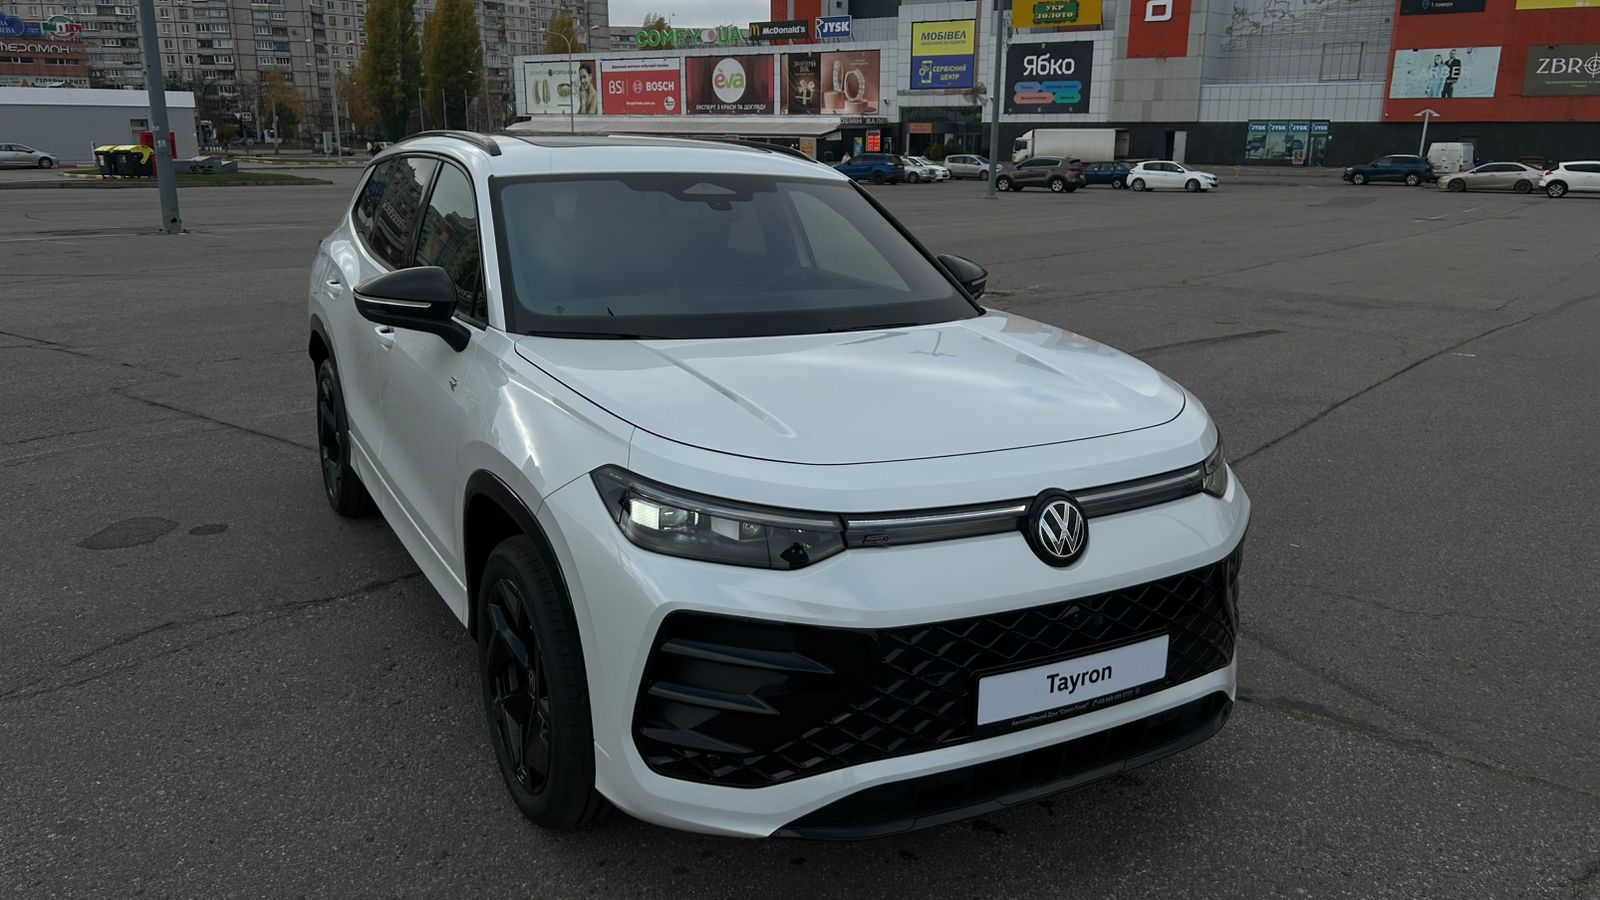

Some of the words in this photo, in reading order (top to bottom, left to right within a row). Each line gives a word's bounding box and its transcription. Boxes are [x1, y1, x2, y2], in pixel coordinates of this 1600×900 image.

[763, 26, 806, 35] McDonald's
[823, 21, 850, 33] JYSK
[635, 28, 698, 47] COMFY
[718, 25, 741, 44] UA
[921, 30, 966, 41] МОБІВЕЛ
[1023, 53, 1075, 76] Ябко
[646, 81, 675, 92] BOSCH
[1046, 665, 1113, 694] Tayron
